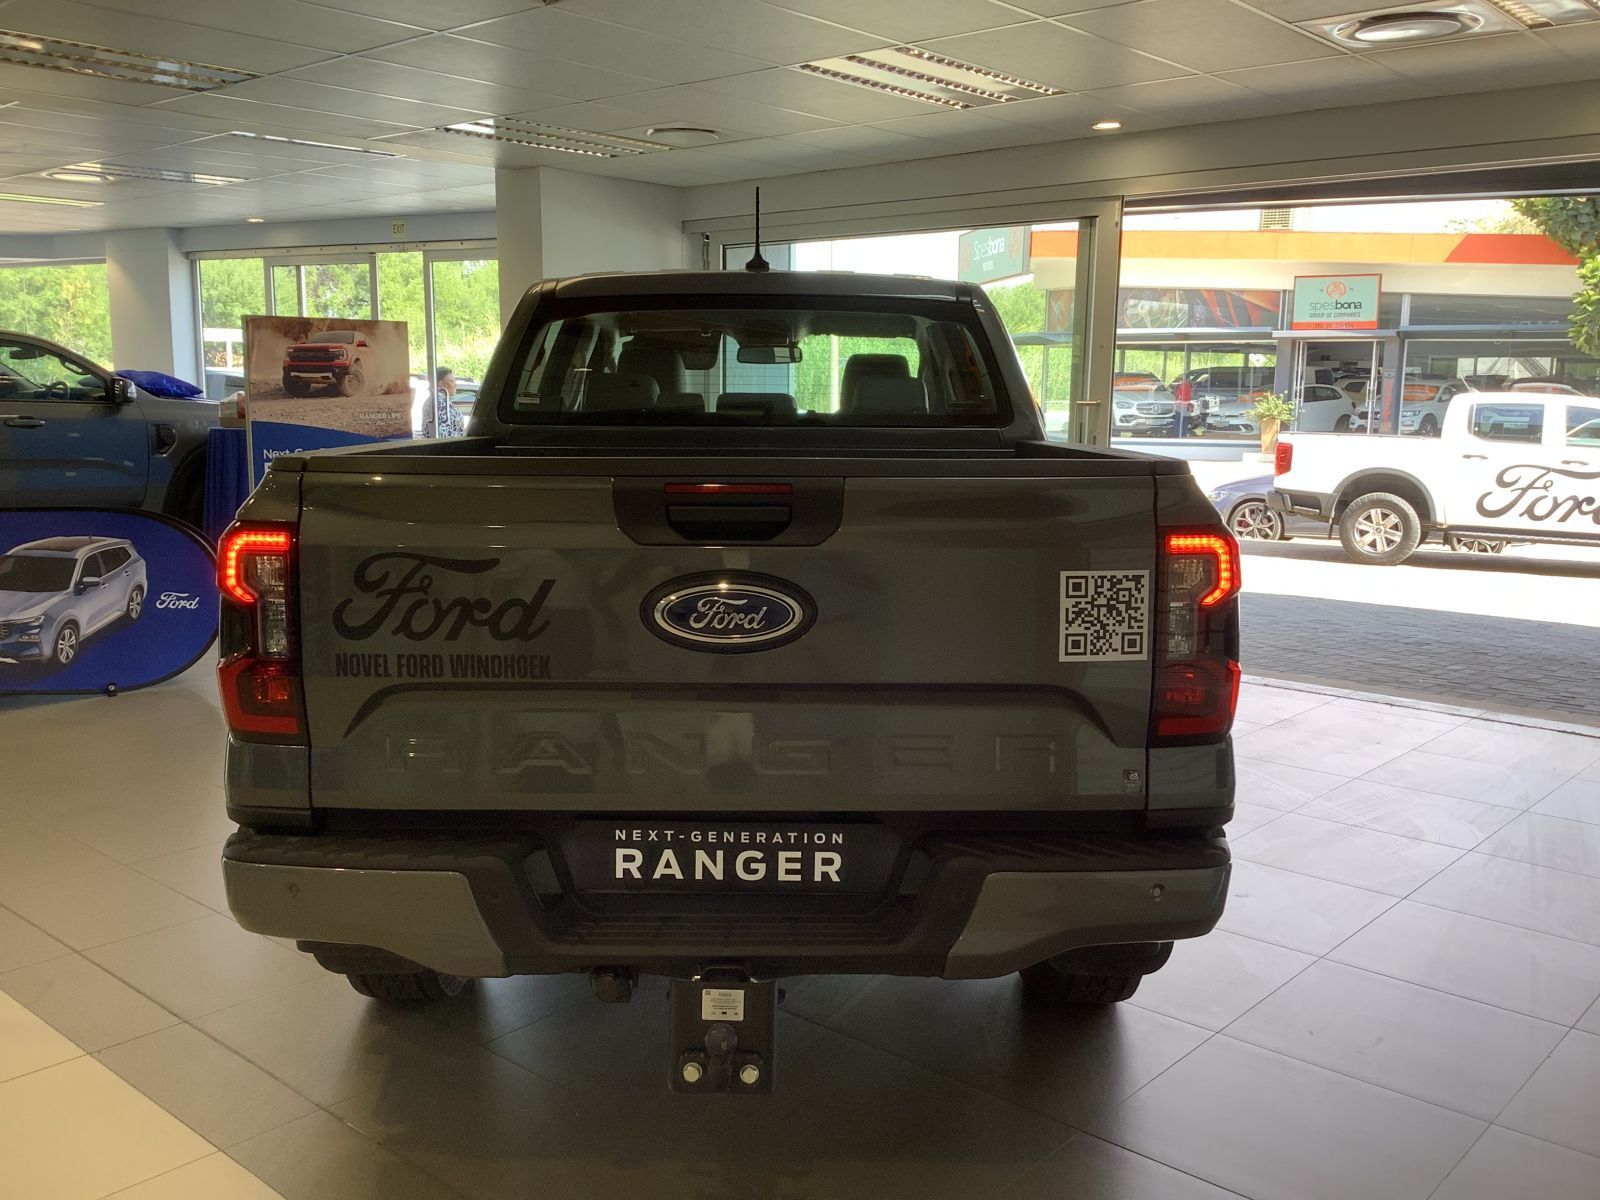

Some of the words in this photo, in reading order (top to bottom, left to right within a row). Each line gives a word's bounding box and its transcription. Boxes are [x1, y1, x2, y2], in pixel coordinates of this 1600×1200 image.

[1309, 300, 1362, 312] spesbona
[359, 412, 387, 420] RANGER
[387, 412, 401, 420] LIFE
[1476, 464, 1600, 525] For
[156, 591, 199, 609] Ford
[332, 552, 557, 642] Ford
[689, 597, 768, 629] Ford
[335, 653, 392, 677] NOVEL
[396, 654, 445, 678] FORD
[450, 654, 552, 679] WINDHOEK
[615, 829, 844, 844] NEXT-GENERATION
[615, 848, 842, 882] RANGER
